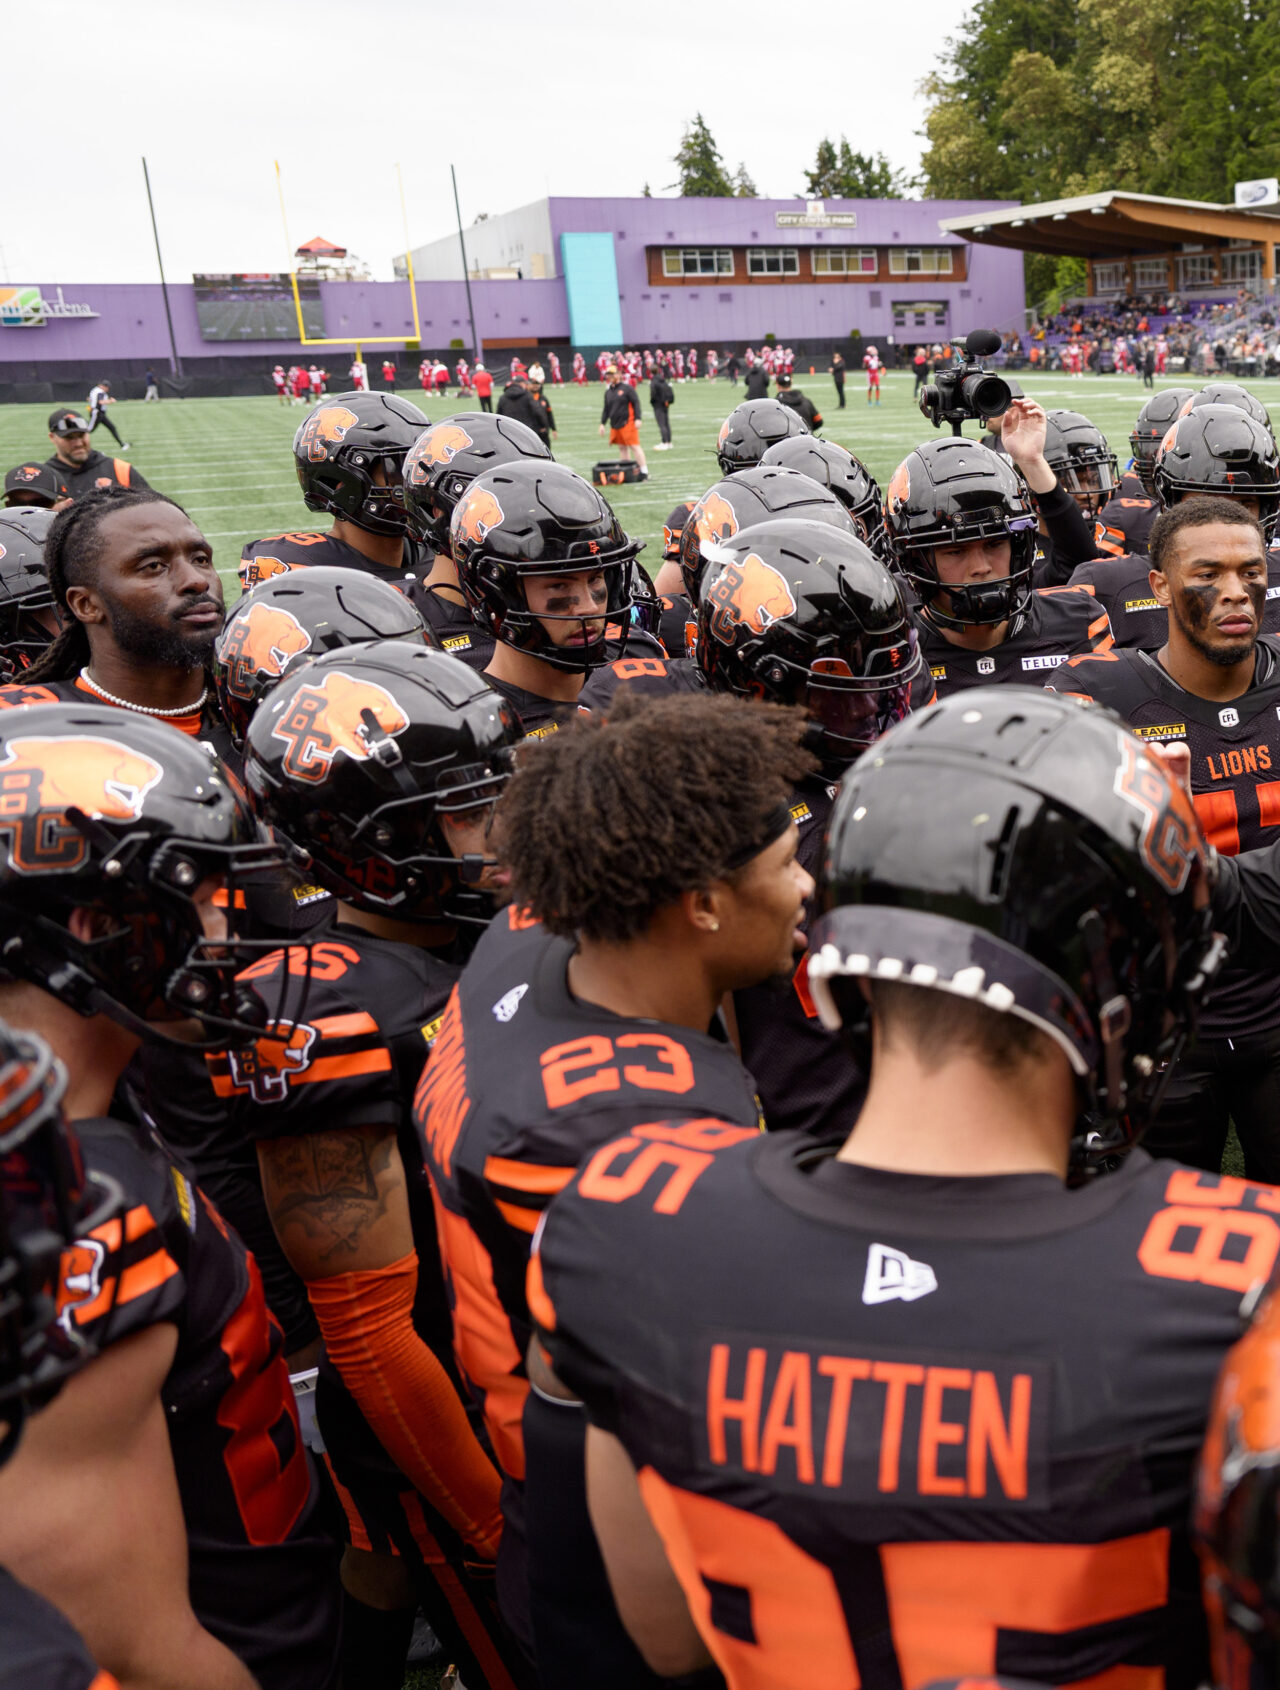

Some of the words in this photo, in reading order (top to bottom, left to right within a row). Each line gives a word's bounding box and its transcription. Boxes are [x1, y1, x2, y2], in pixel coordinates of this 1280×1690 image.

[443, 634, 469, 648] VITT
[980, 662, 994, 672] CFL
[1221, 712, 1235, 723] CFL
[273, 690, 333, 786] BC
[1206, 744, 1273, 781] LIONS
[539, 1032, 696, 1109] 23
[705, 1344, 1033, 1500] HATTEN
